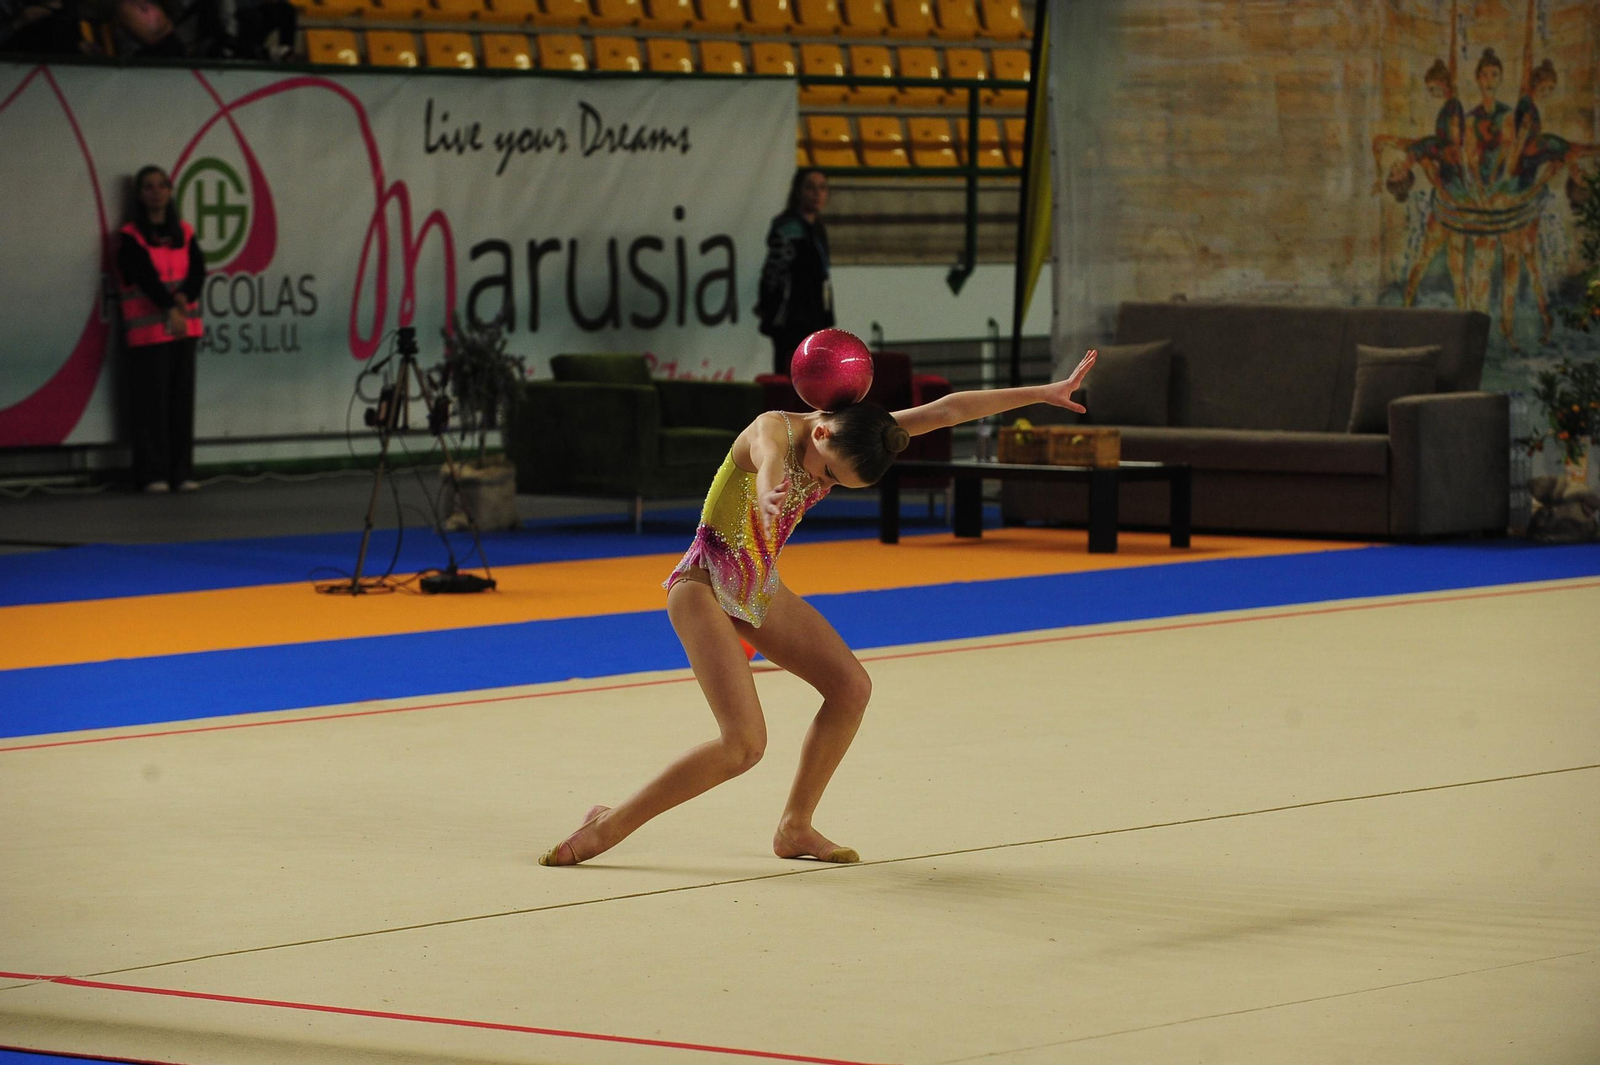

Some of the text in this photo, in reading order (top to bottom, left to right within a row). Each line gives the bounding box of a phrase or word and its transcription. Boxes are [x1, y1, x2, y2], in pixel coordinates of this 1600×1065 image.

[424, 98, 692, 177] Live your Dreams
